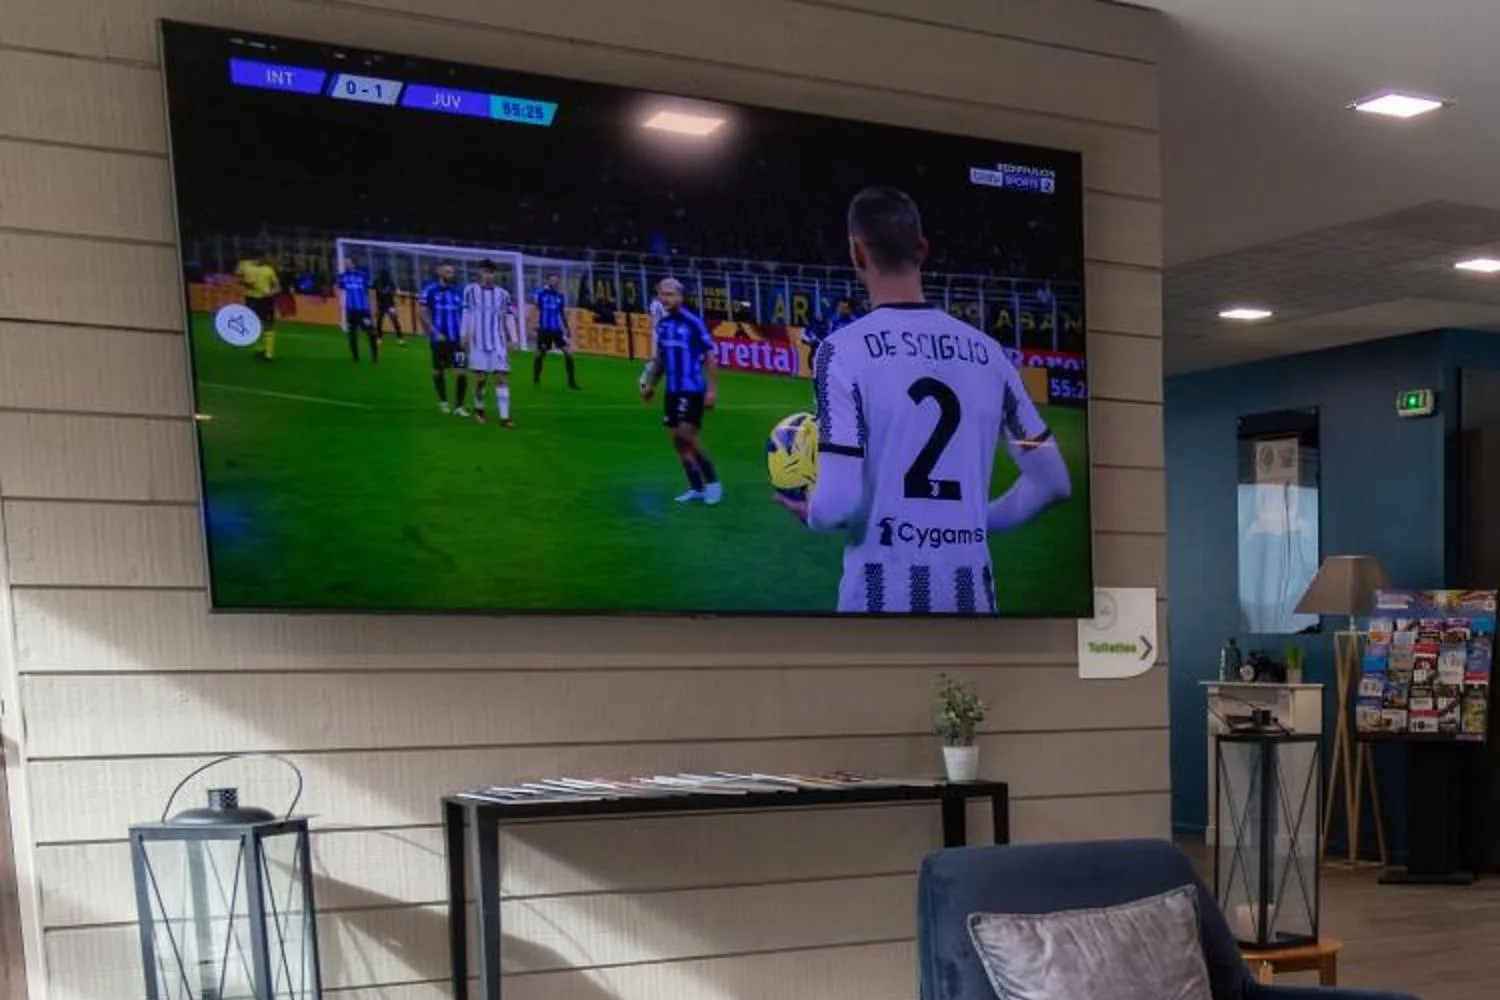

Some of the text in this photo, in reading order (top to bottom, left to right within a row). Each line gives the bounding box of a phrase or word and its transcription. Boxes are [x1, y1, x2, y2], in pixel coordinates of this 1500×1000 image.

[265, 68, 293, 86] INT
[346, 80, 357, 96] 0
[375, 83, 383, 98] 1
[431, 92, 461, 109] JUV
[863, 330, 897, 359] DE
[902, 331, 989, 366] SCIGLIO
[904, 376, 962, 500] 2
